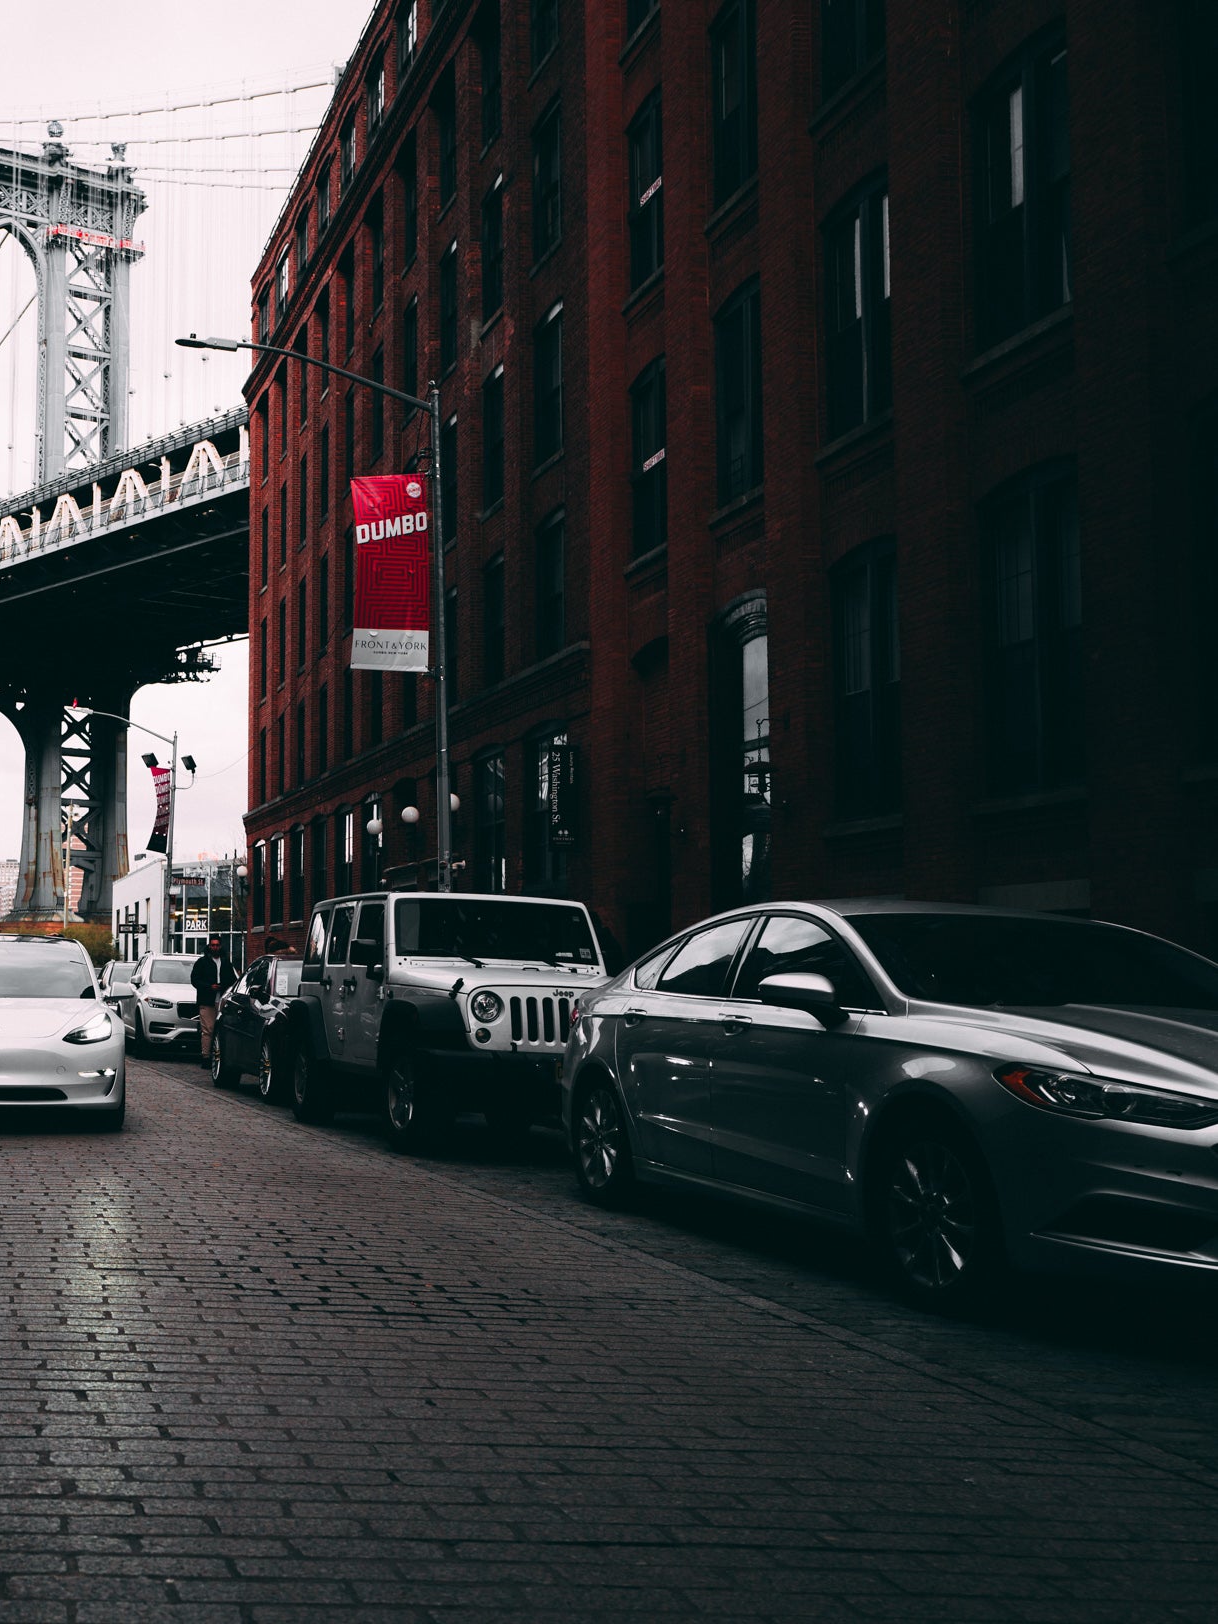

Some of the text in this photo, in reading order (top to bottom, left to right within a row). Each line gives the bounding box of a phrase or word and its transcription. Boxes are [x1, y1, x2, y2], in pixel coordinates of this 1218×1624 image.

[355, 511, 428, 545] DUMBO
[354, 640, 390, 649] FRONT
[398, 641, 427, 651] YORK
[549, 751, 561, 825] 25 Washington St.
[185, 919, 207, 931] PARK
[552, 989, 574, 998] Jeep
